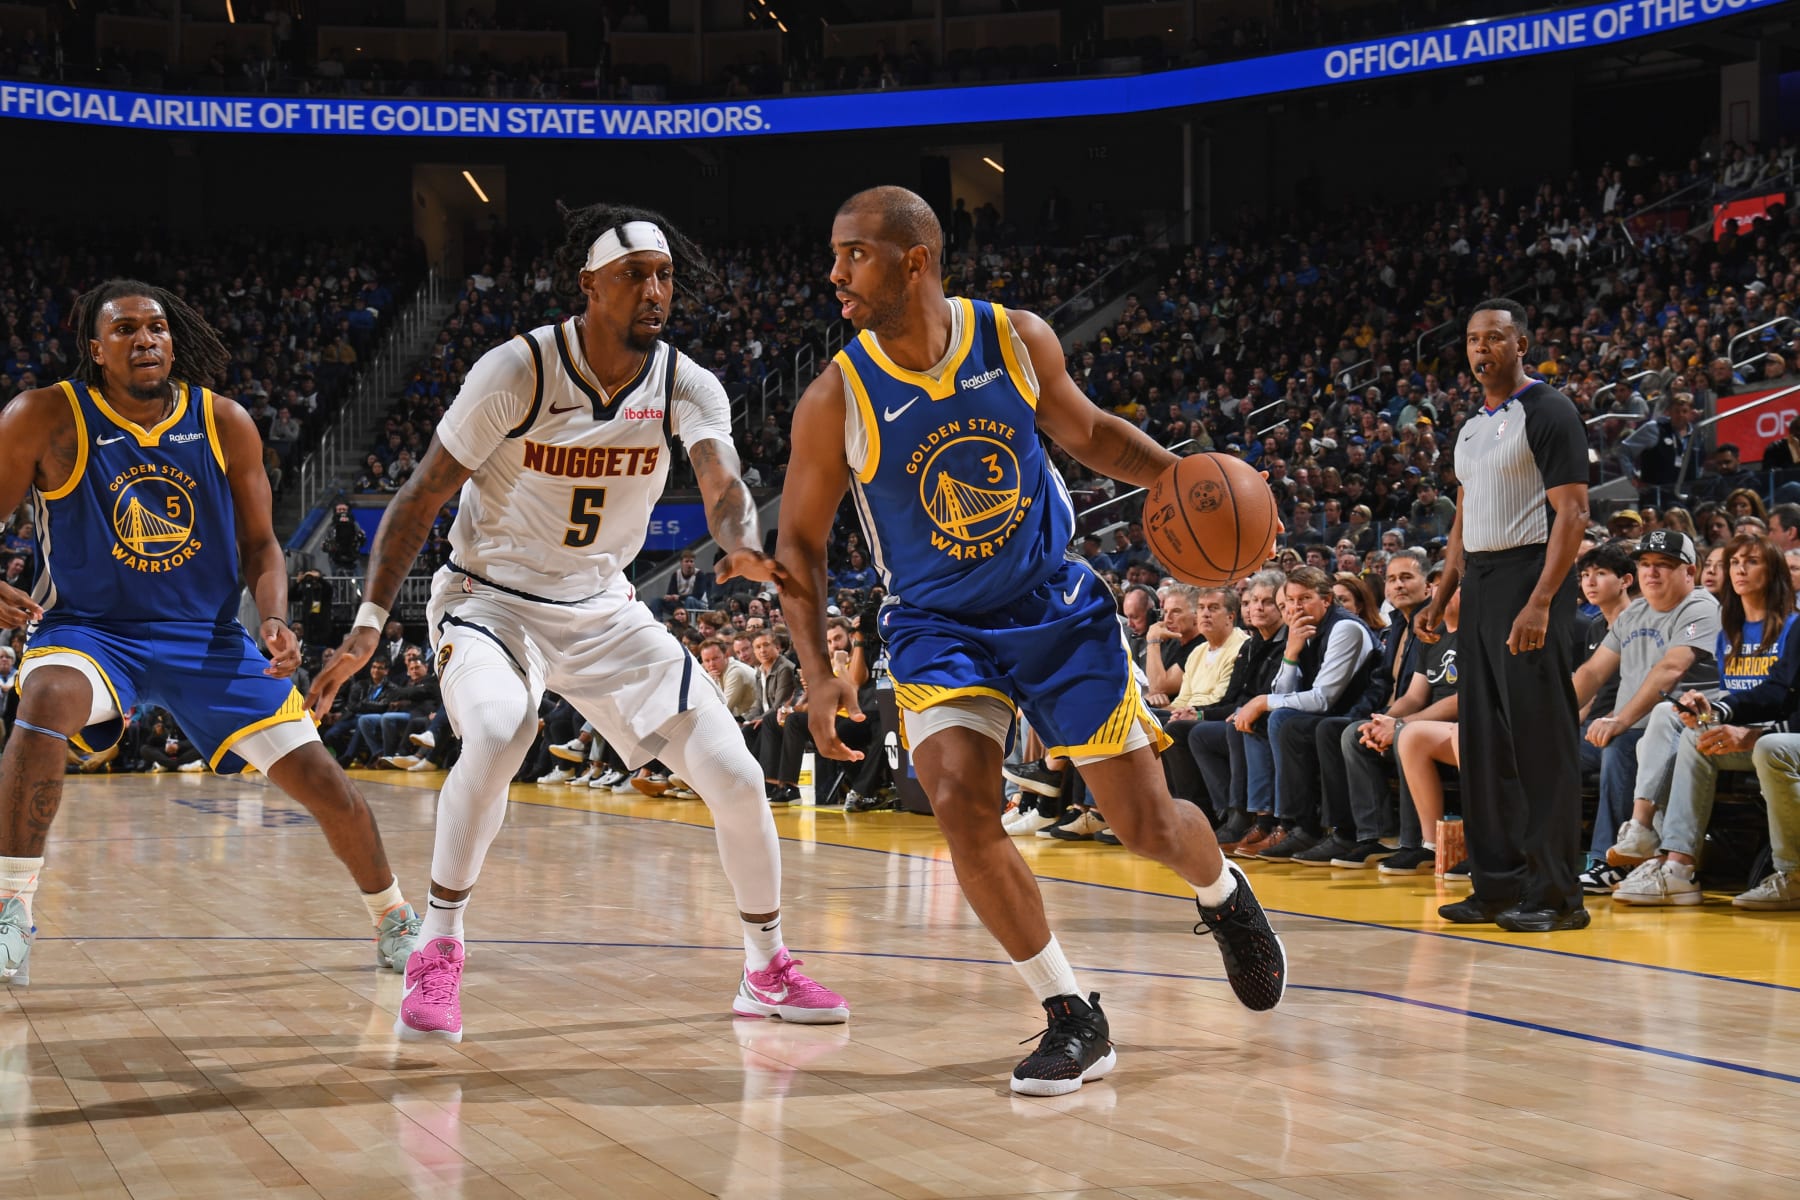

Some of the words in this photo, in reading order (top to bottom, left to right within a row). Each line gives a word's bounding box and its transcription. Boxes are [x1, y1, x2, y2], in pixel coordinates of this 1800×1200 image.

[1325, 34, 1458, 79] OFFICIAL
[1463, 14, 1586, 58] AIRLINE
[1593, 5, 1633, 39] OF
[1638, 0, 1695, 29] THE
[129, 98, 253, 128] AIRLINE
[259, 102, 301, 129] OF
[305, 104, 365, 130] THE
[371, 105, 500, 133] GOLDEN
[507, 107, 595, 134] STATE
[600, 105, 771, 135] WARRIORS.
[960, 368, 1004, 391] Rakuten
[624, 407, 664, 420] ibotta
[168, 432, 205, 444] Rakuten
[906, 421, 961, 475] GOLDEN
[968, 418, 1016, 441] STATE
[523, 438, 660, 478] NUGGETS
[981, 453, 1004, 484] 3
[110, 464, 156, 492] GOLDEN
[162, 464, 198, 491] STATE
[166, 495, 182, 519] 5
[563, 485, 608, 548] 5
[112, 539, 202, 573] WARRIORS
